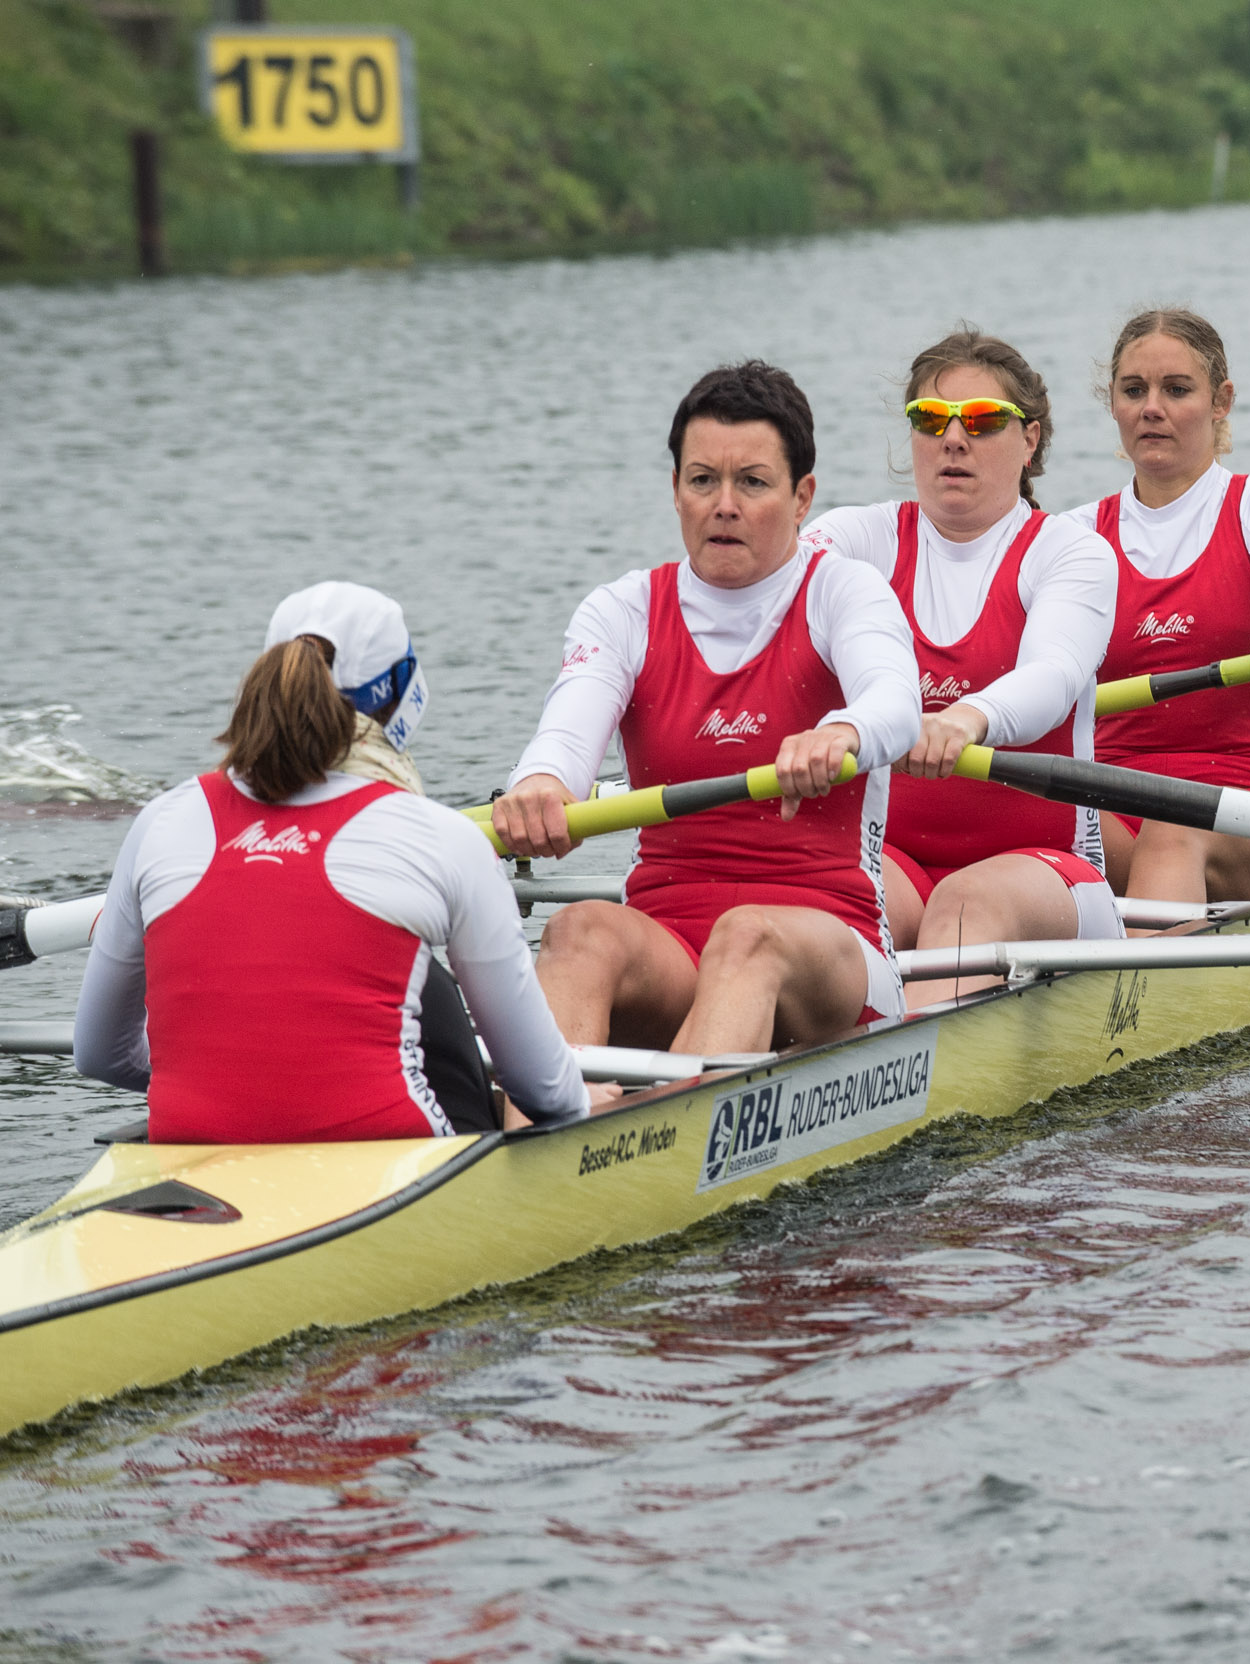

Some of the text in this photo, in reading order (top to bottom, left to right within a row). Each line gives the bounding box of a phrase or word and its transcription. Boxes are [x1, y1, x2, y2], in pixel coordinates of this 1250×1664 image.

[212, 56, 386, 128] 1750
[1133, 611, 1191, 640] Melitta
[694, 707, 763, 740] Melitta
[220, 819, 312, 855] Melitta
[786, 1049, 930, 1139] RUDER-BUNDESLIGA
[732, 1082, 783, 1156] RBL
[638, 1120, 677, 1157] Minden
